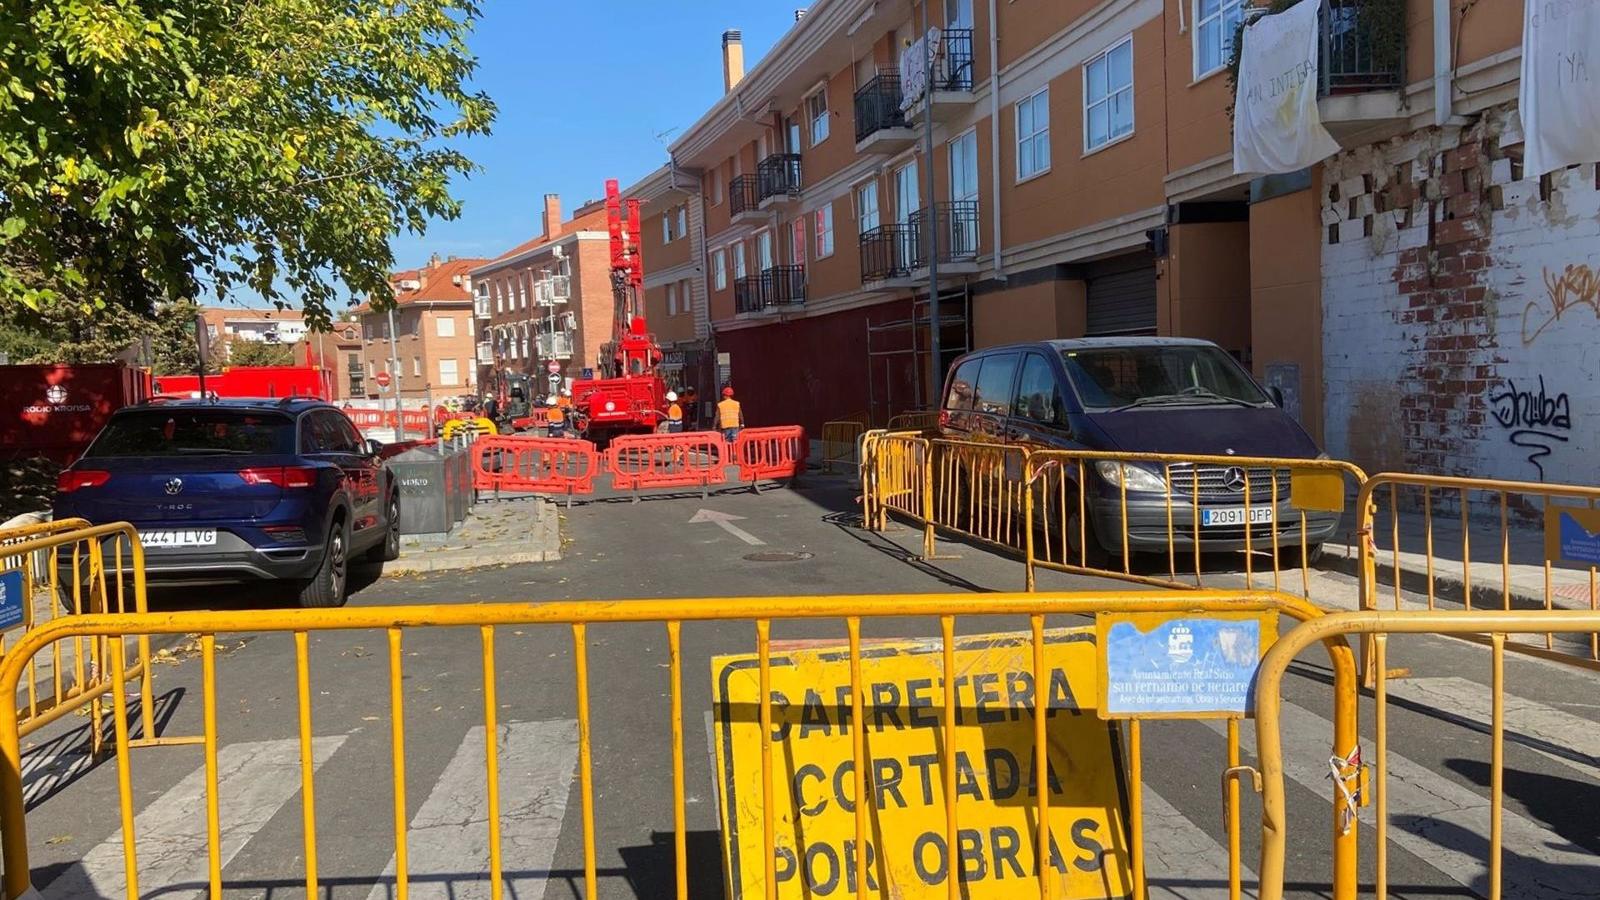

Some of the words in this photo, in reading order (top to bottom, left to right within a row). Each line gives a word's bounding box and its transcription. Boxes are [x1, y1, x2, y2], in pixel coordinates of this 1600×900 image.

[141, 530, 177, 544] 4441
[183, 529, 213, 543] LVG
[1211, 510, 1243, 523] 2091
[759, 668, 1082, 742] CARRETERA
[1208, 681, 1248, 693] Henare
[793, 745, 1063, 817] CORTADA
[774, 838, 880, 897] POR
[913, 818, 1105, 886] OBRAS
